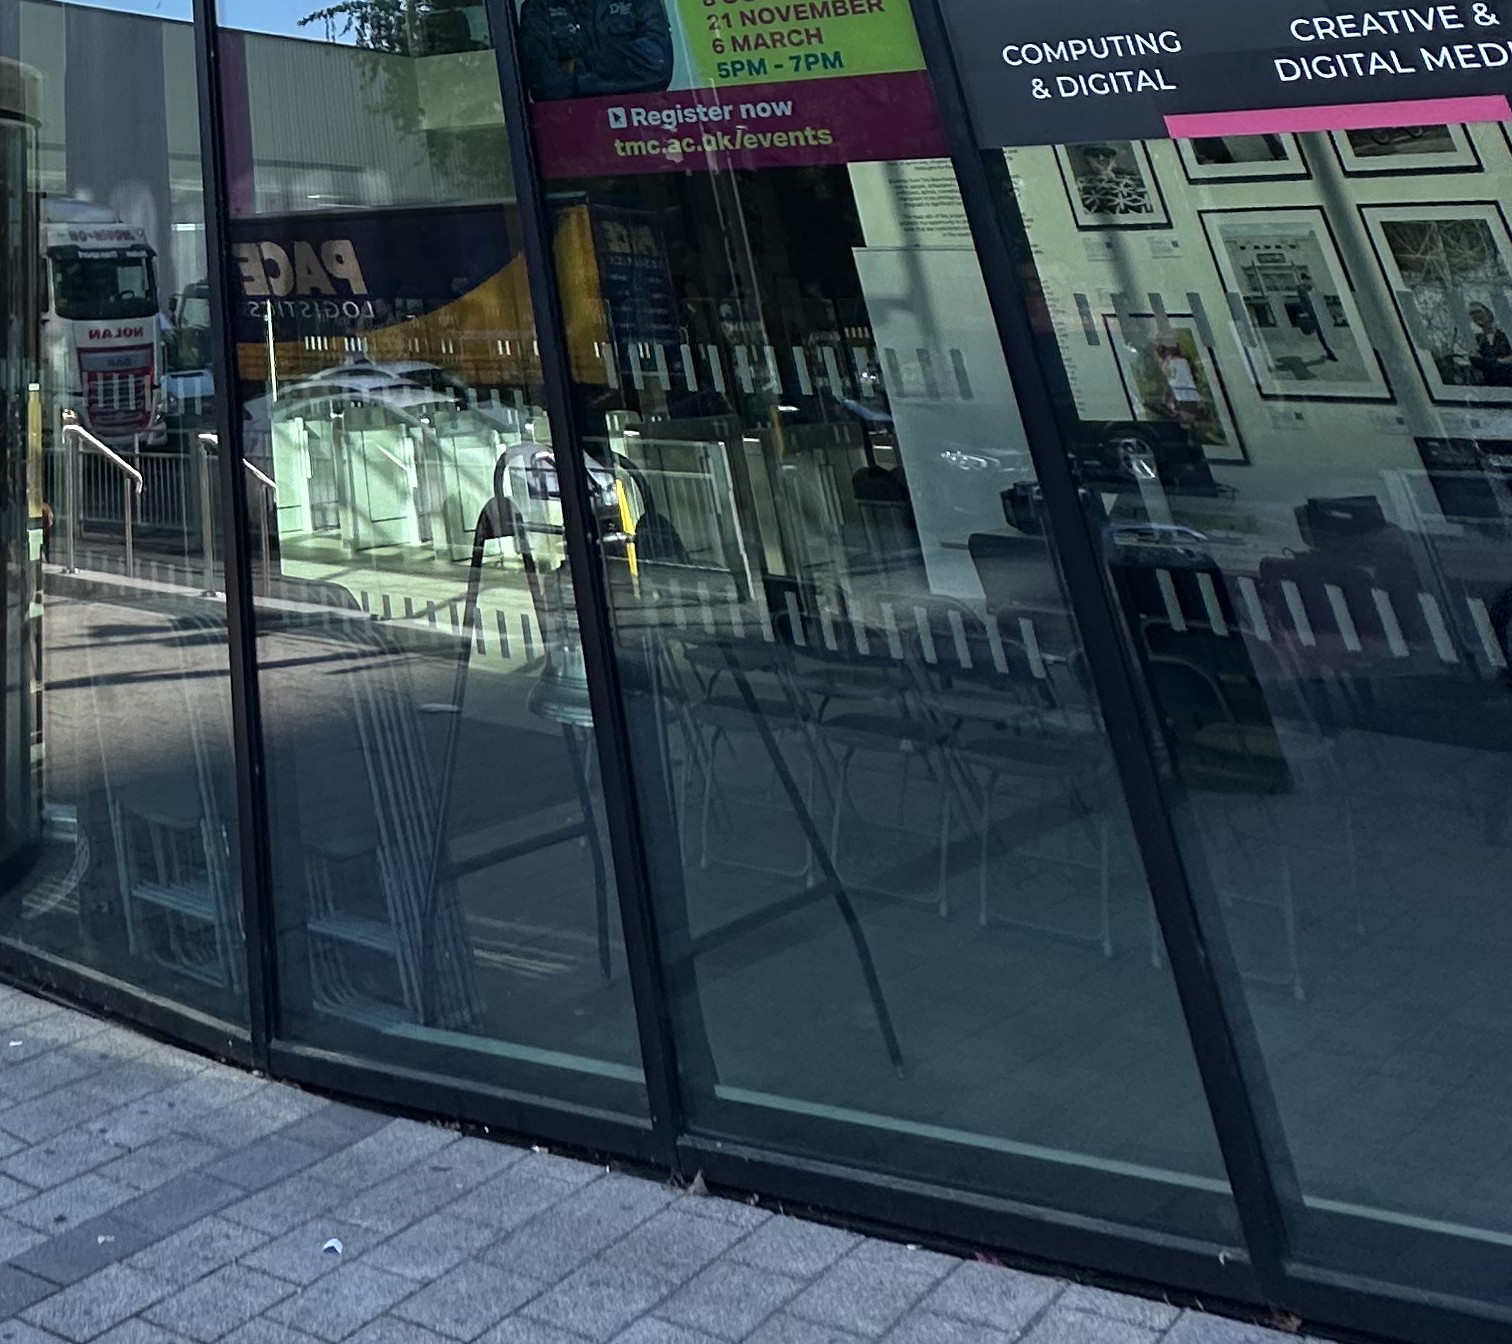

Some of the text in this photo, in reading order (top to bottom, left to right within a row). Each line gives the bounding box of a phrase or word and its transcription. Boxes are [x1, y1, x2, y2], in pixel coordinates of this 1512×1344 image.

[707, 13, 733, 31] 21
[1290, 2, 1500, 42] CREATIVE &
[712, 27, 824, 54] 6 MARCH
[1002, 30, 1182, 66] COMPUTING
[717, 58, 768, 79] 5PM
[789, 51, 844, 72] 7PM
[1273, 49, 1416, 82] DIGITAL
[1031, 69, 1177, 99] & DIGITAL
[630, 100, 793, 129] Register now
[614, 126, 833, 157] tmc.ac.uk/events
